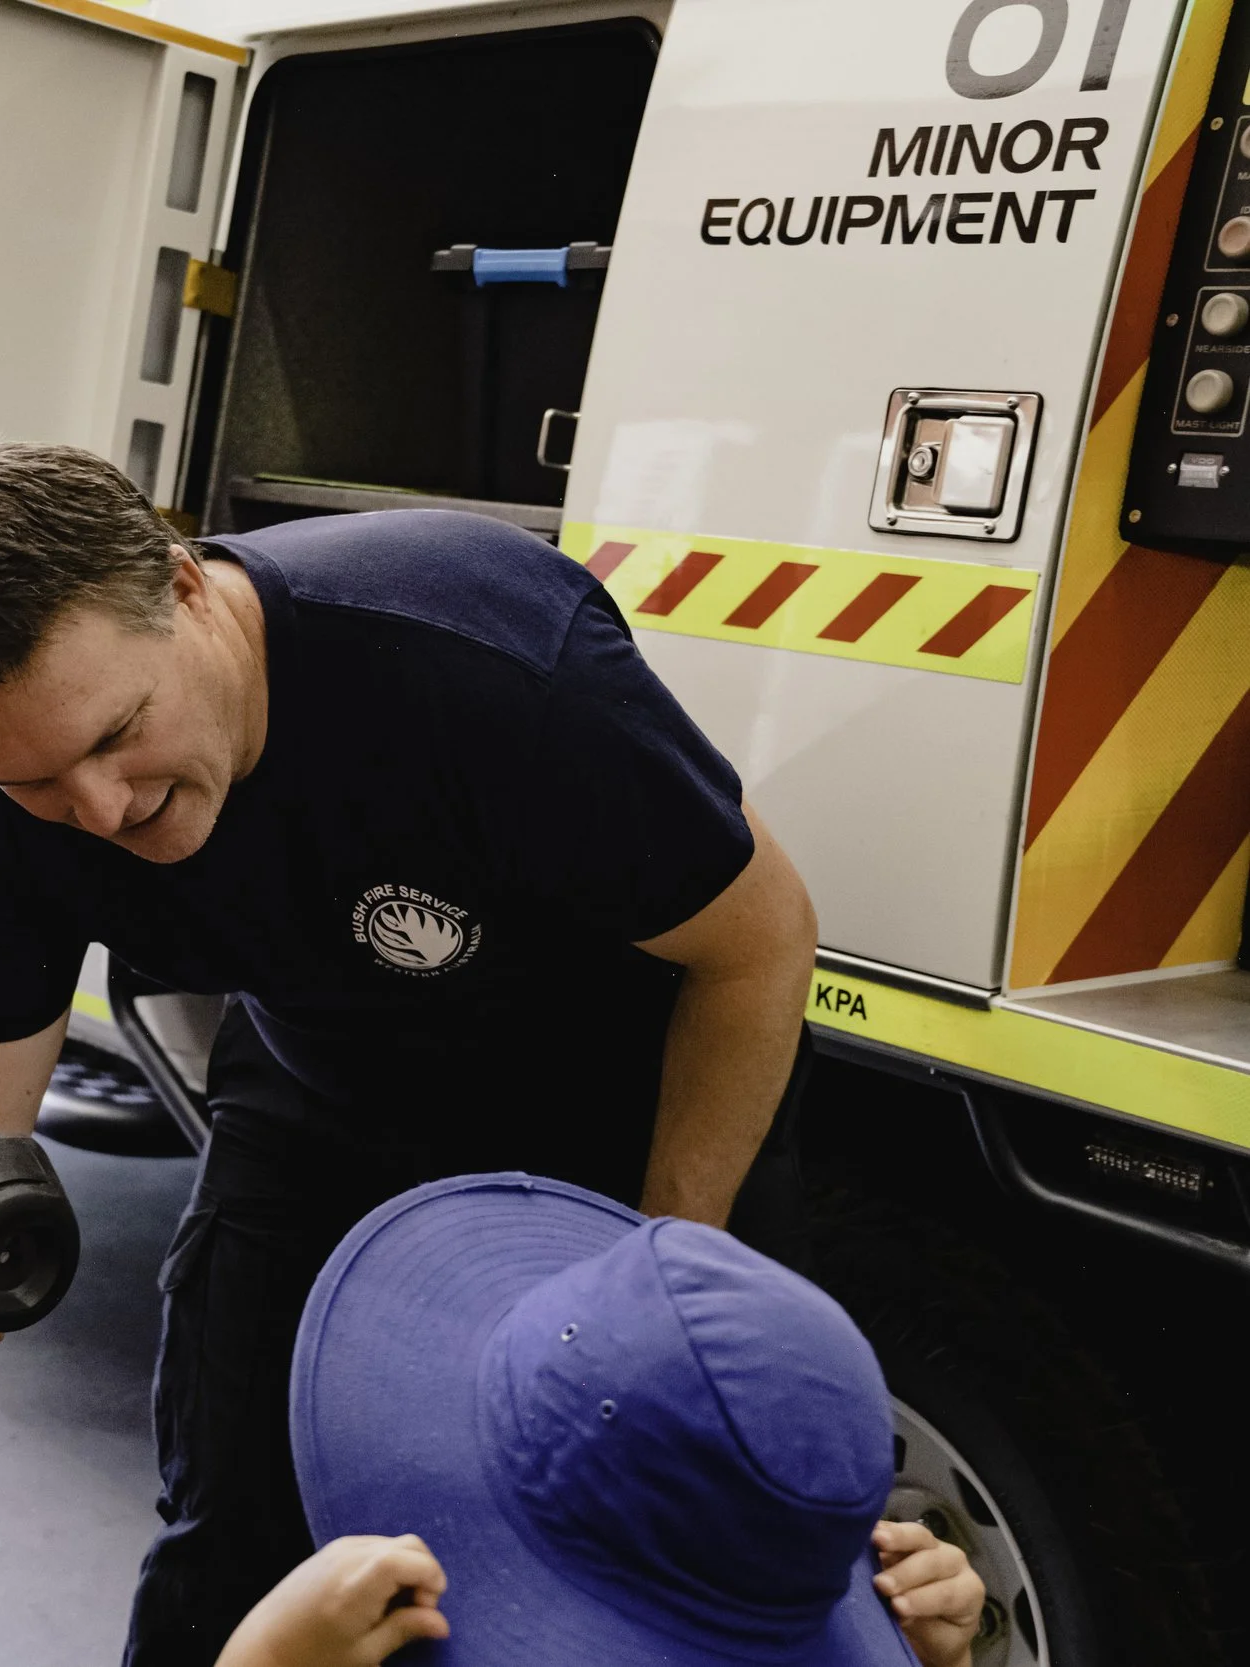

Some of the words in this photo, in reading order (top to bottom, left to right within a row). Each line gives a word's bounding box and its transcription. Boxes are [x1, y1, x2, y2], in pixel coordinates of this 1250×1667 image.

[867, 117, 1109, 178] MINOR
[700, 189, 1096, 245] EQUIPMENT
[1175, 419, 1206, 429] MAST
[1209, 421, 1241, 430] LIGHT
[352, 901, 368, 943] BUSH
[363, 884, 395, 904] FIRE
[399, 885, 468, 920] SERVICE
[816, 983, 867, 1020] KPA
